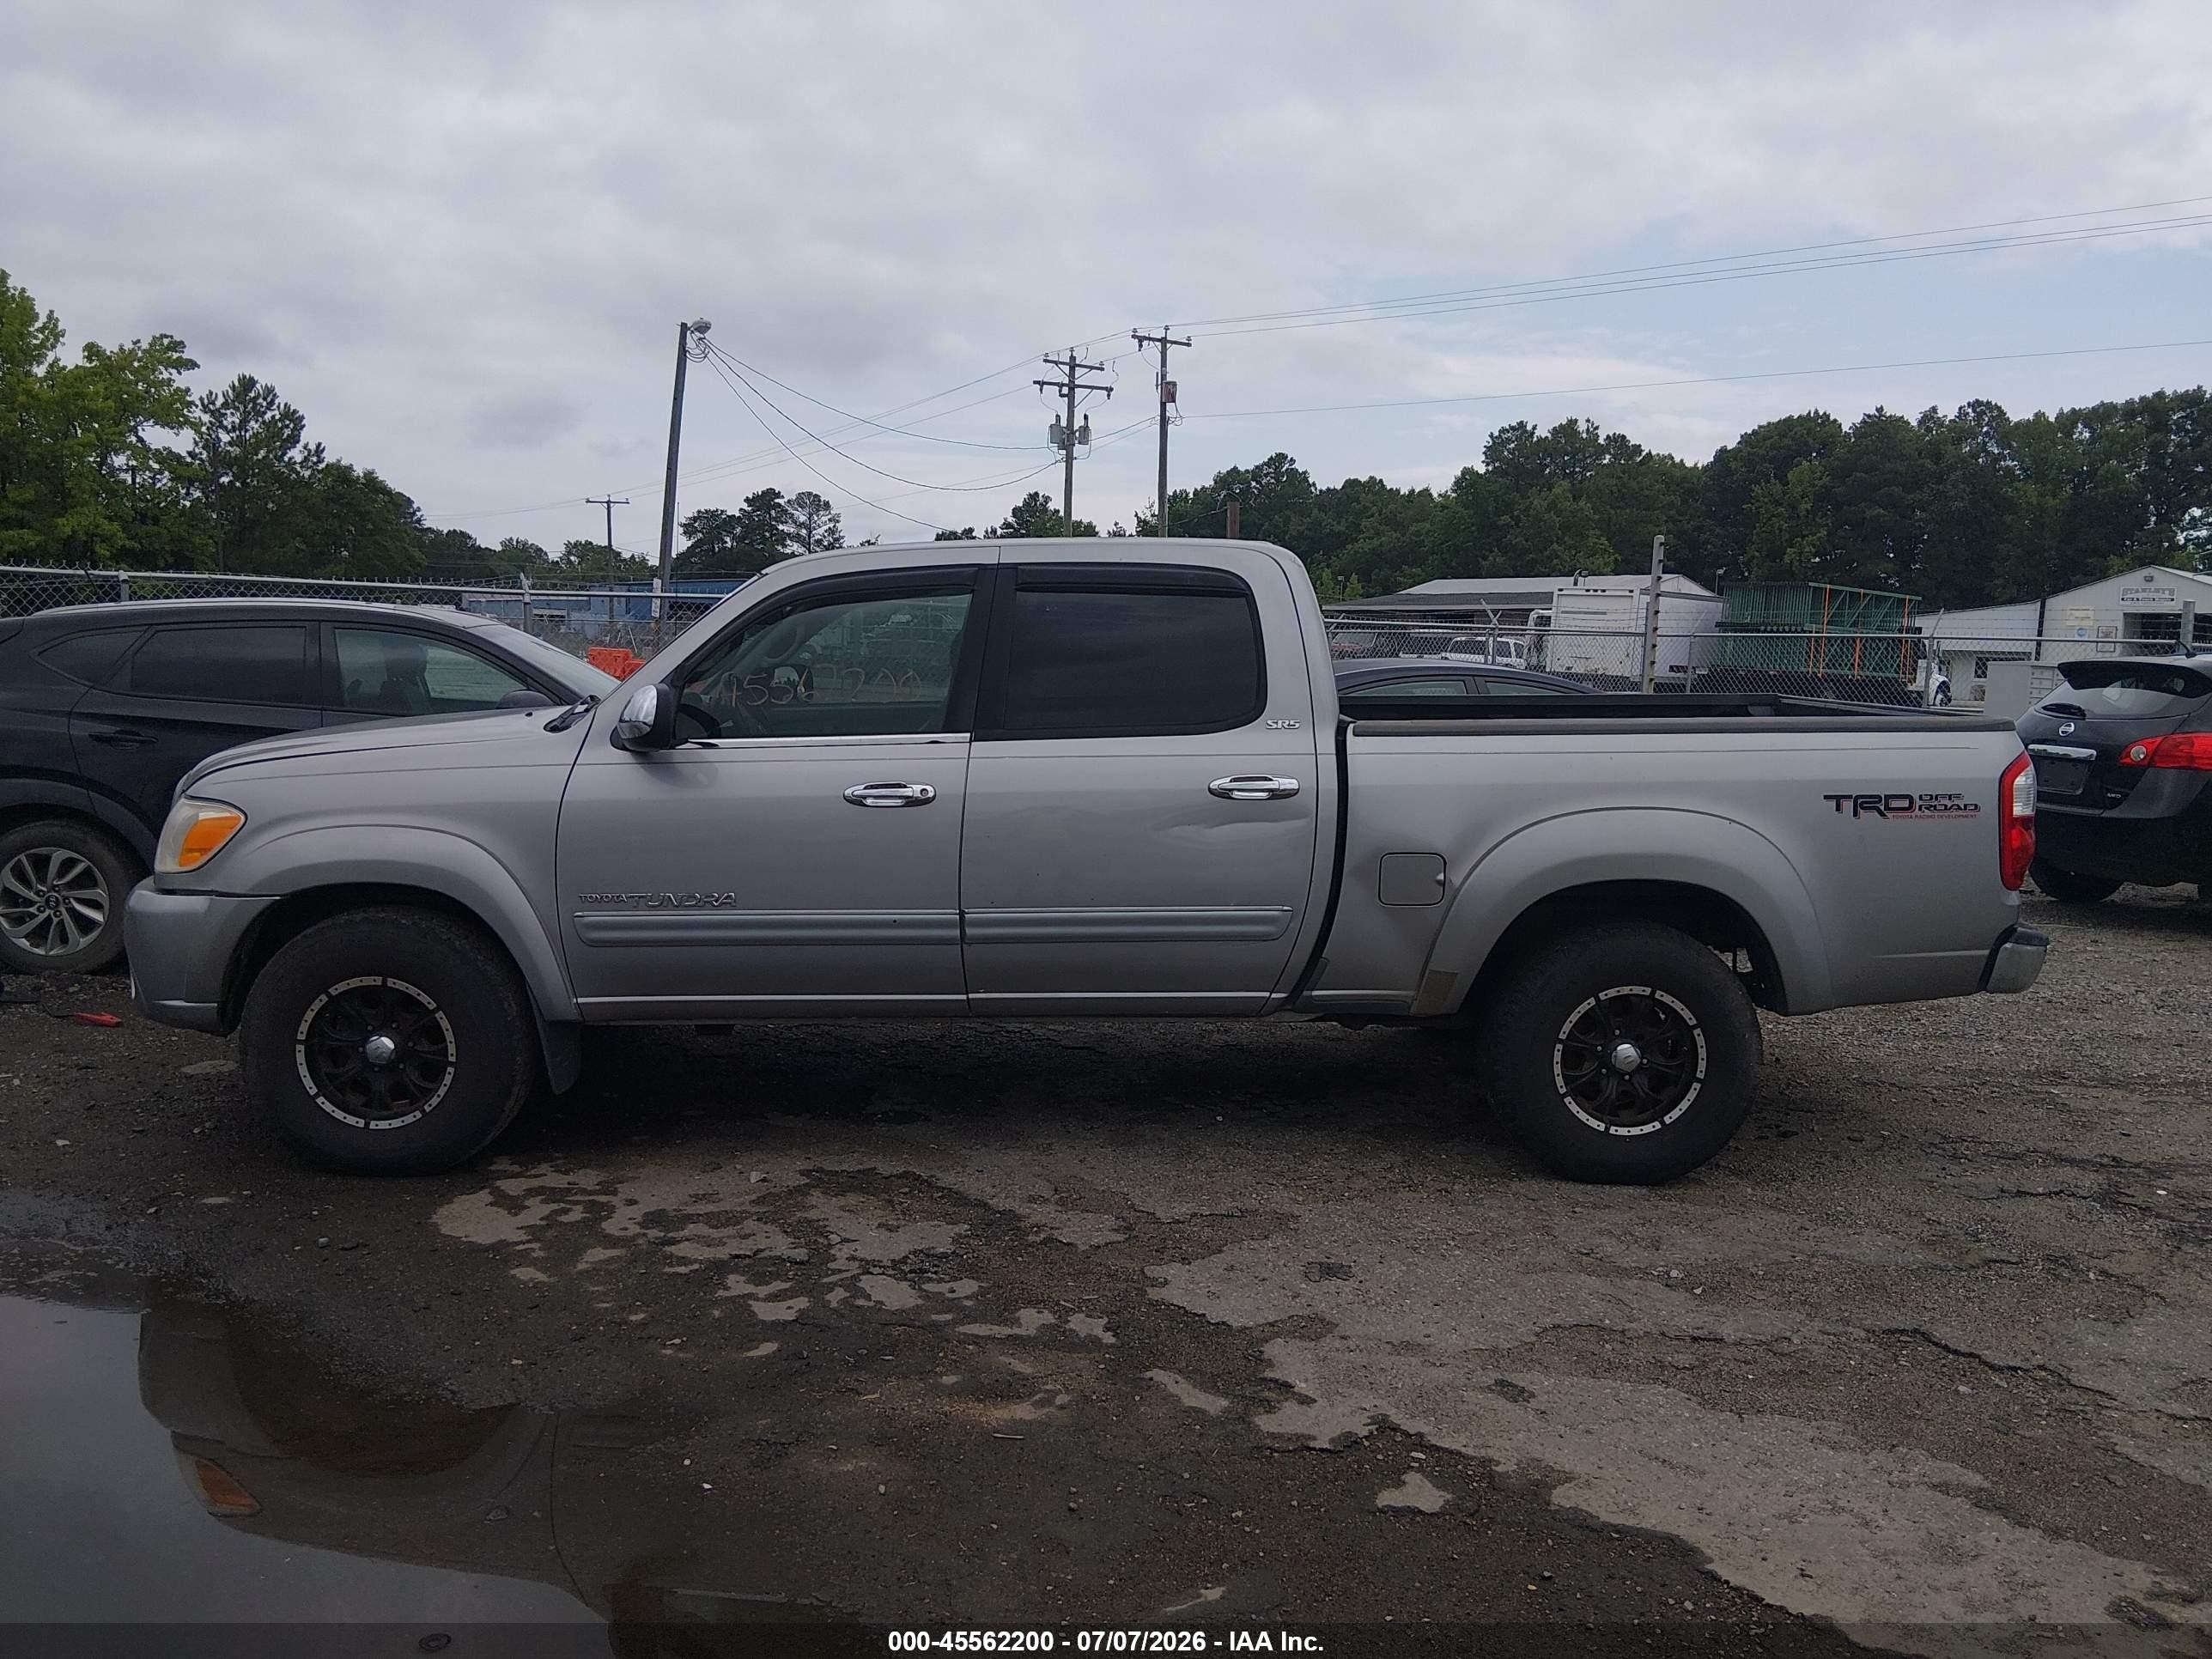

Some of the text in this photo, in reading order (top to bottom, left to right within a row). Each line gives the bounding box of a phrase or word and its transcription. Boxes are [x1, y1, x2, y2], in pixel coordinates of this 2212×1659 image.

[1265, 720, 1301, 729] SR5
[1918, 793, 1964, 803] OFF
[1822, 794, 1917, 819] TRD
[1918, 804, 1981, 812] ROAD
[578, 893, 736, 908] TOYOTA TUNDRA
